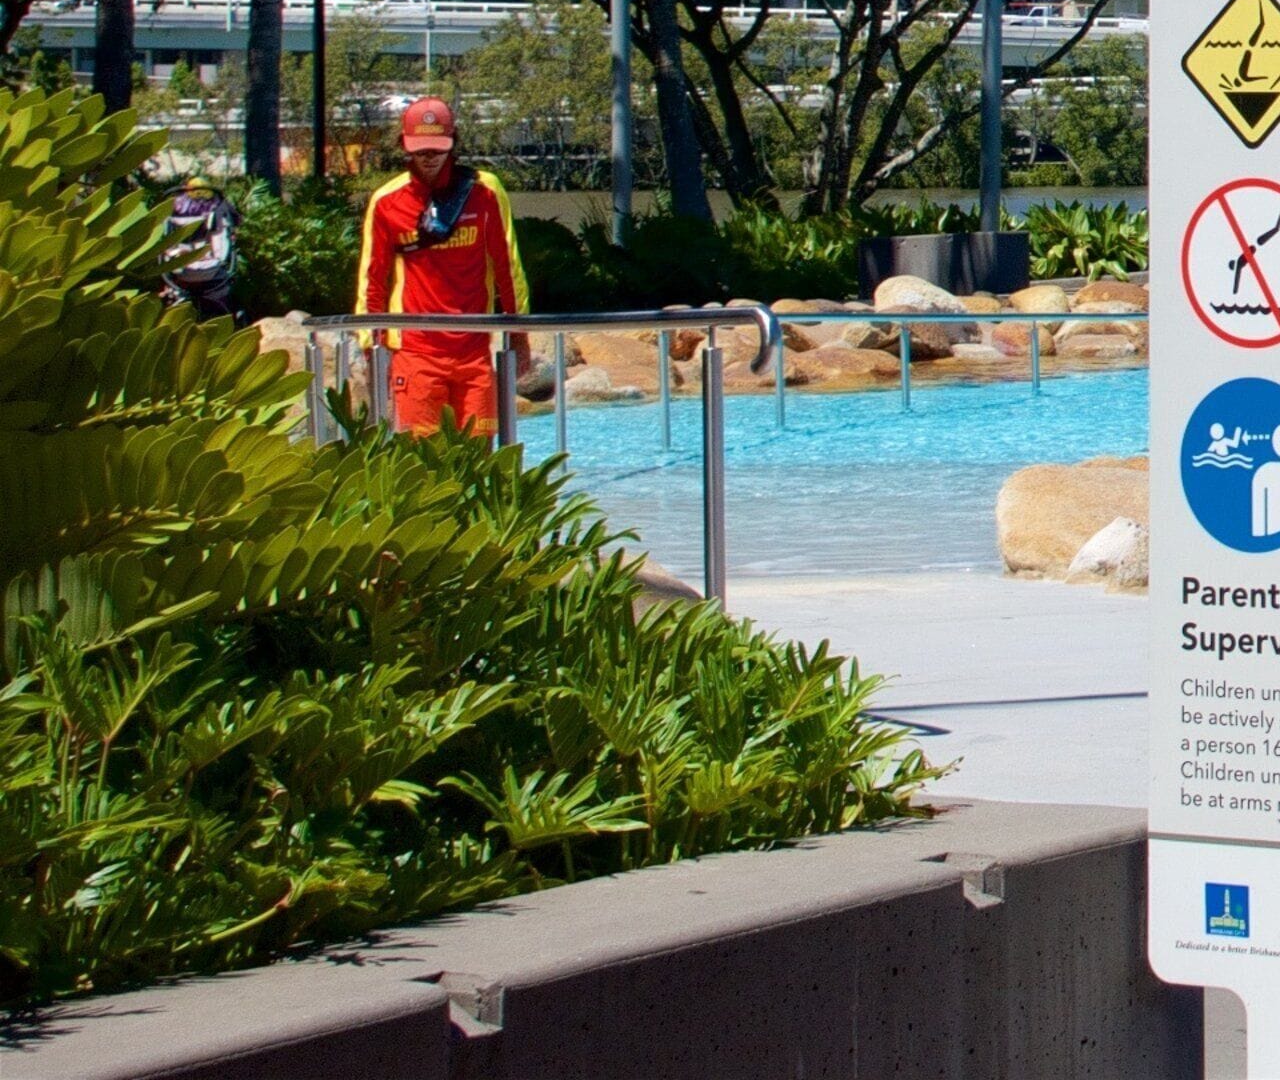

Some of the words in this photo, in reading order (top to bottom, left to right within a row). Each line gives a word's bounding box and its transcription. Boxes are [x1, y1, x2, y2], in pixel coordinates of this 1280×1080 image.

[1180, 678, 1256, 700] Children
[1180, 704, 1203, 725] be
[1208, 709, 1275, 735] actively
[1180, 737, 1191, 752] a
[1196, 738, 1256, 757] person
[1180, 760, 1255, 783] Children
[1180, 787, 1203, 807] be
[1208, 793, 1225, 809] at
[1229, 796, 1272, 812] arms
[1175, 940, 1210, 951] Dedicated
[1227, 944, 1248, 954] better
[1249, 946, 1280, 957] Brisbane
